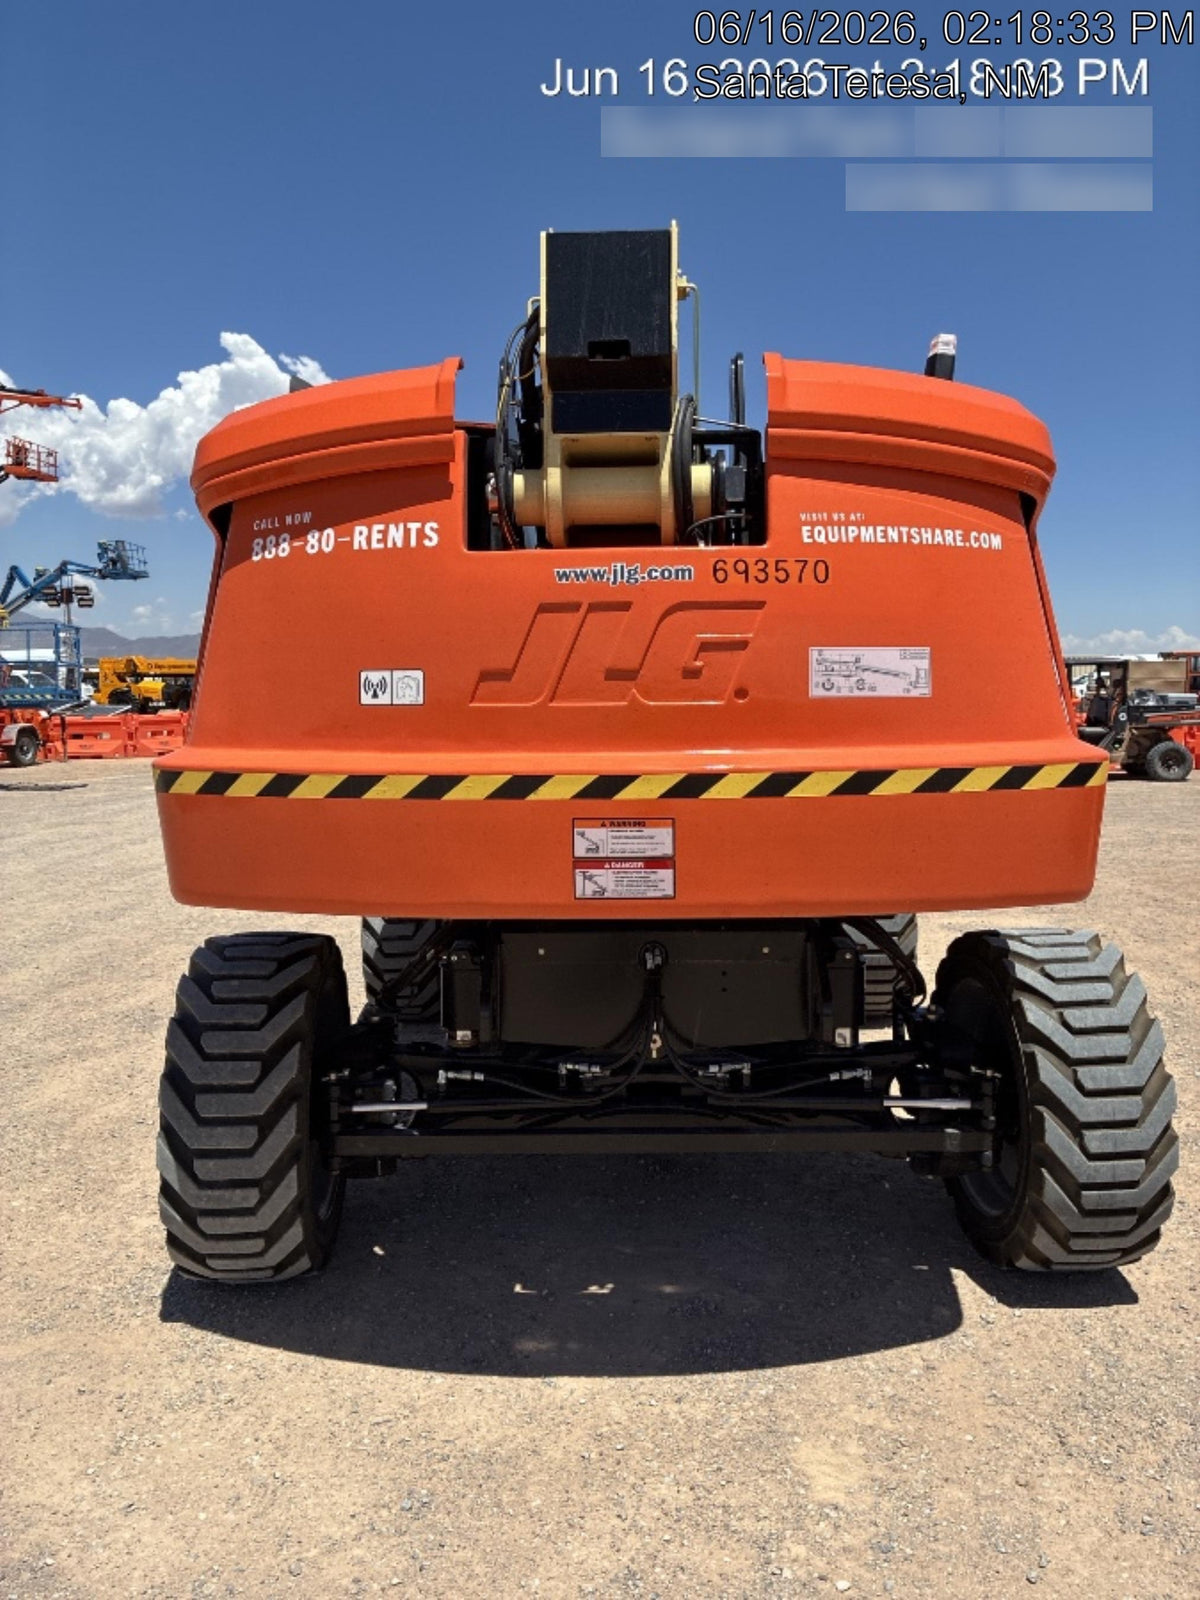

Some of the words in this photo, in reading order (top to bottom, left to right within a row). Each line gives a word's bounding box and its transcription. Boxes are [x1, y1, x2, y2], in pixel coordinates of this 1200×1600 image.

[253, 516, 280, 531] CALL
[285, 511, 312, 526] NOW
[251, 521, 440, 561] 888-80-RENTS
[801, 525, 1003, 550] EQUIPMENTSHARE.COM
[554, 563, 694, 587] www.jlg.com
[712, 559, 829, 584] 693570
